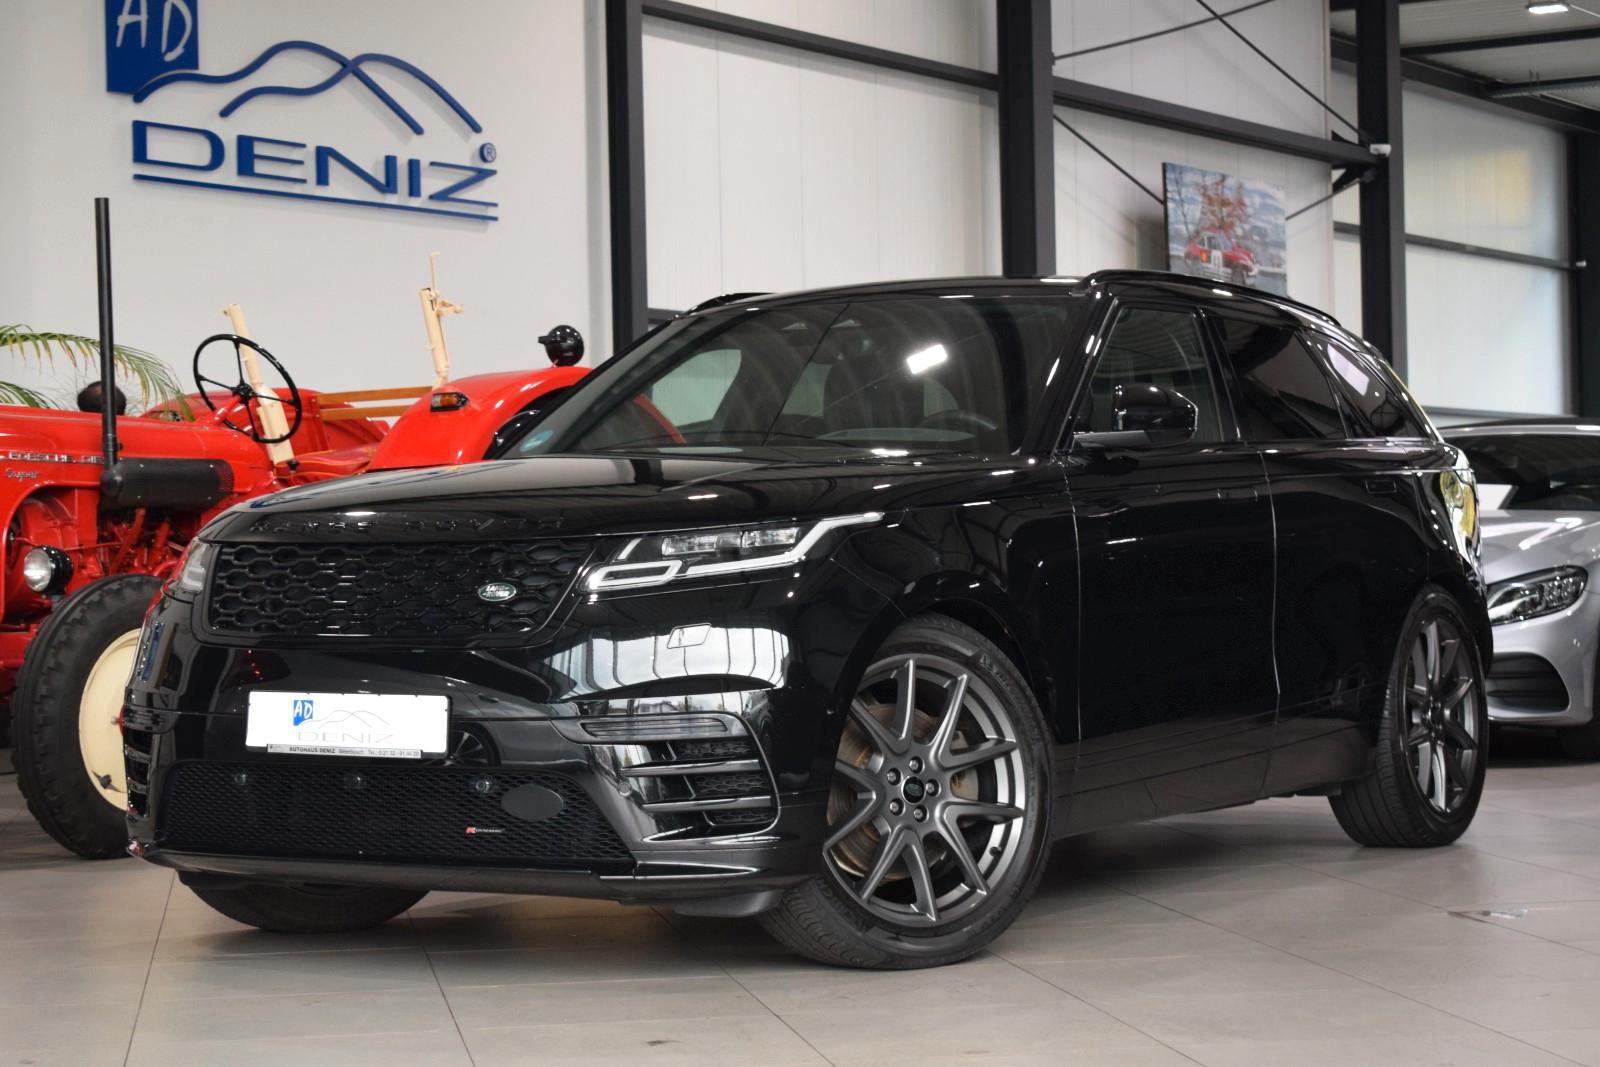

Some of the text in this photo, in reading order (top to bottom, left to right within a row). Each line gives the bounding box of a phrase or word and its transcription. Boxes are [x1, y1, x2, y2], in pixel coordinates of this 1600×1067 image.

[116, 0, 193, 62] AD
[132, 120, 498, 206] DENIZ
[294, 700, 313, 720] AD
[298, 731, 393, 744] DENIZ
